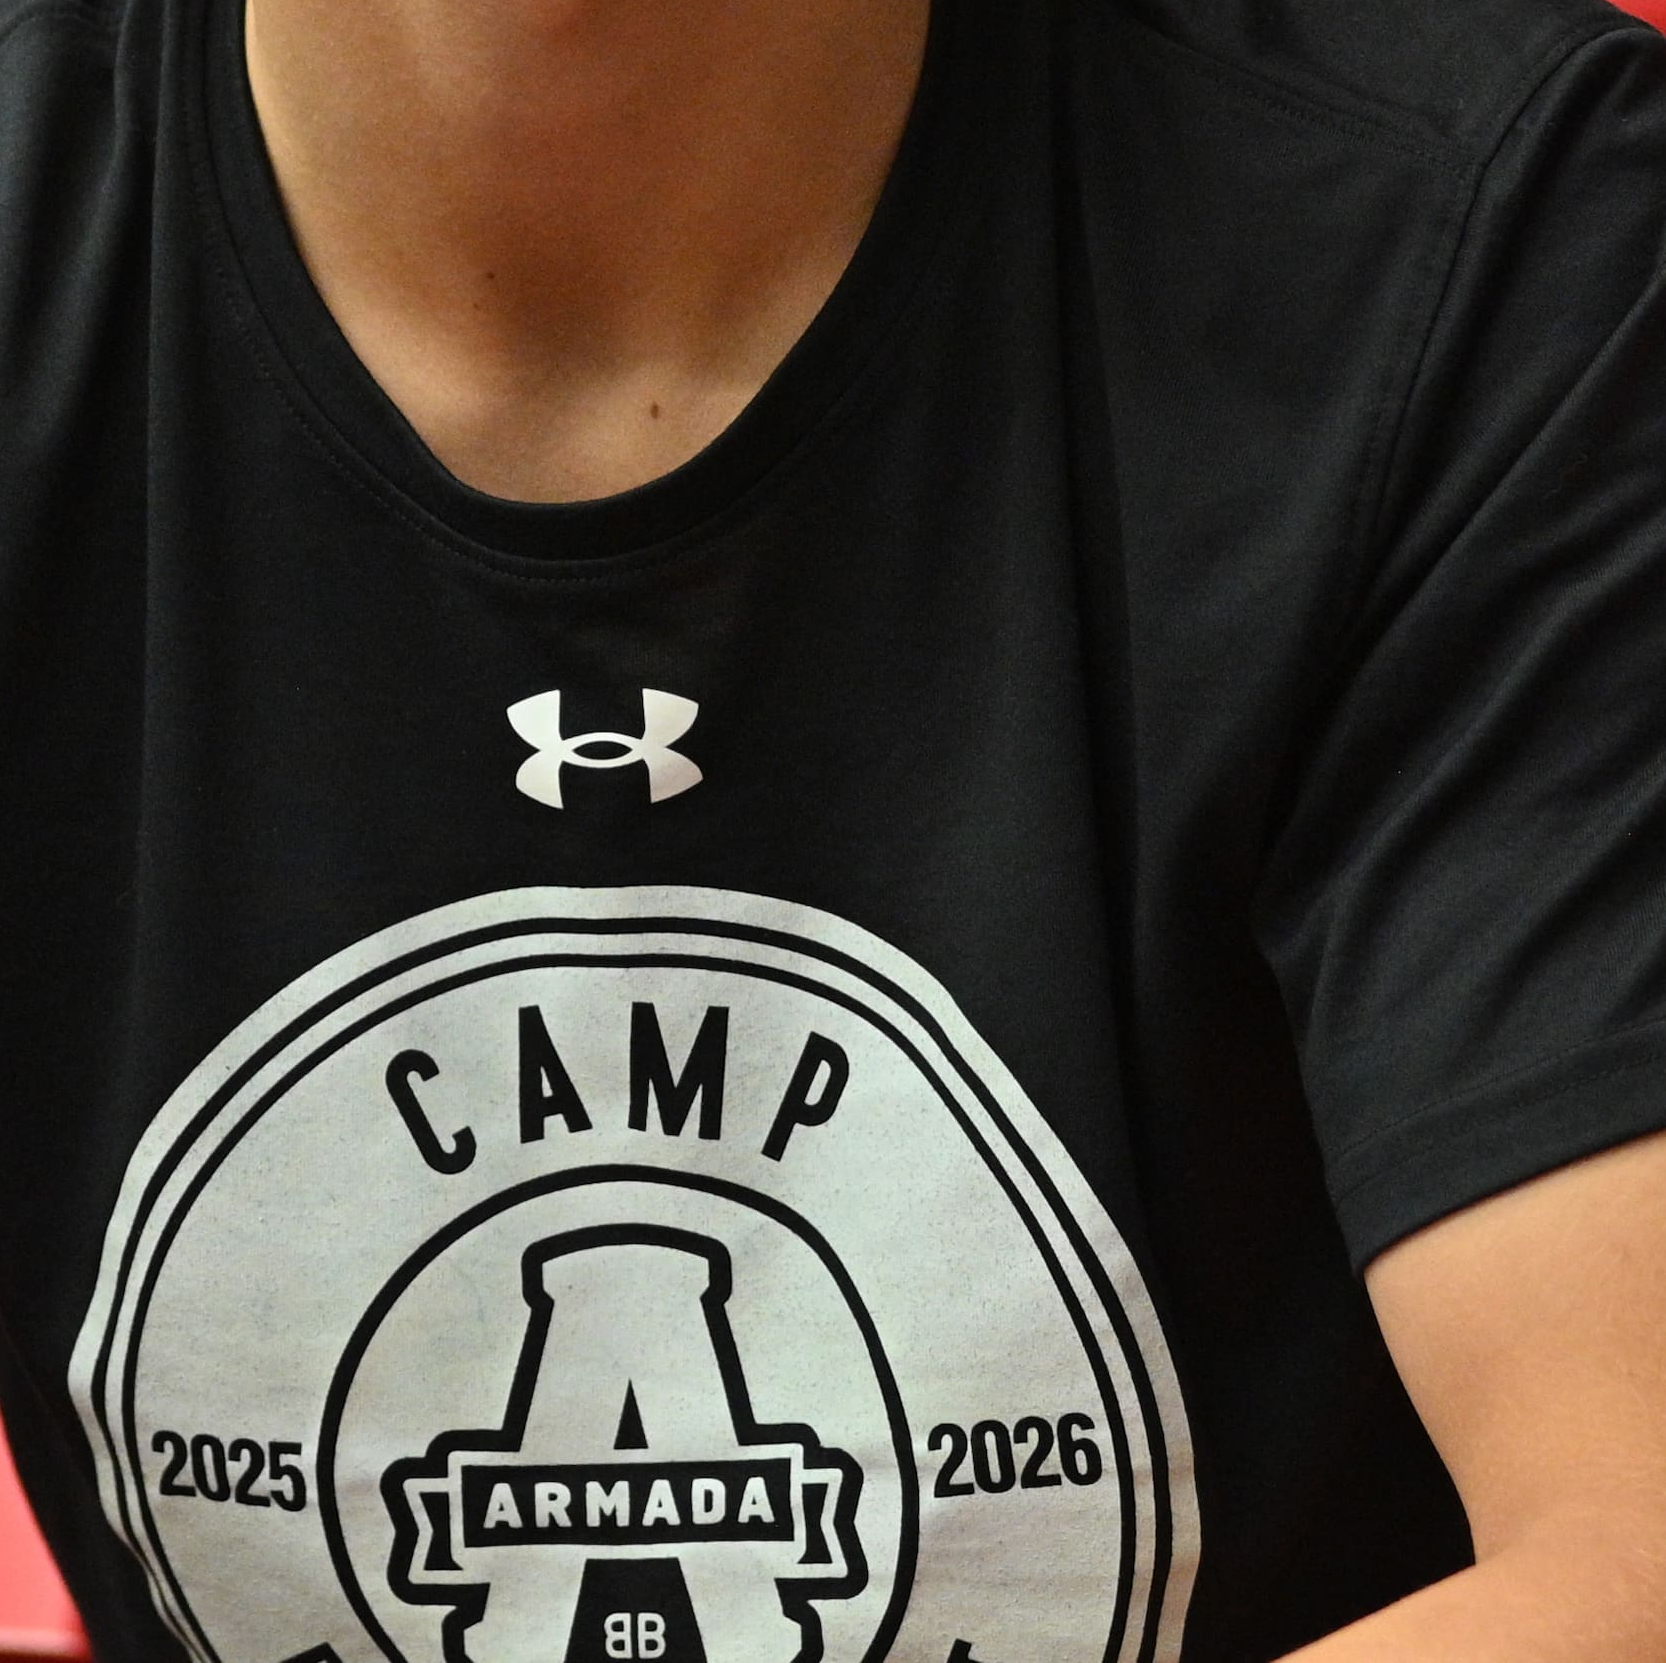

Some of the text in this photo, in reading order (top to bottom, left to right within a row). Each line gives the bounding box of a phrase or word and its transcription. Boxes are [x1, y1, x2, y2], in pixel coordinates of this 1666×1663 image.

[385, 1001, 850, 1176] CAMP
[151, 1429, 307, 1513] 2025
[927, 1412, 1103, 1499] 2026
[483, 1476, 775, 1529] ARMADA
